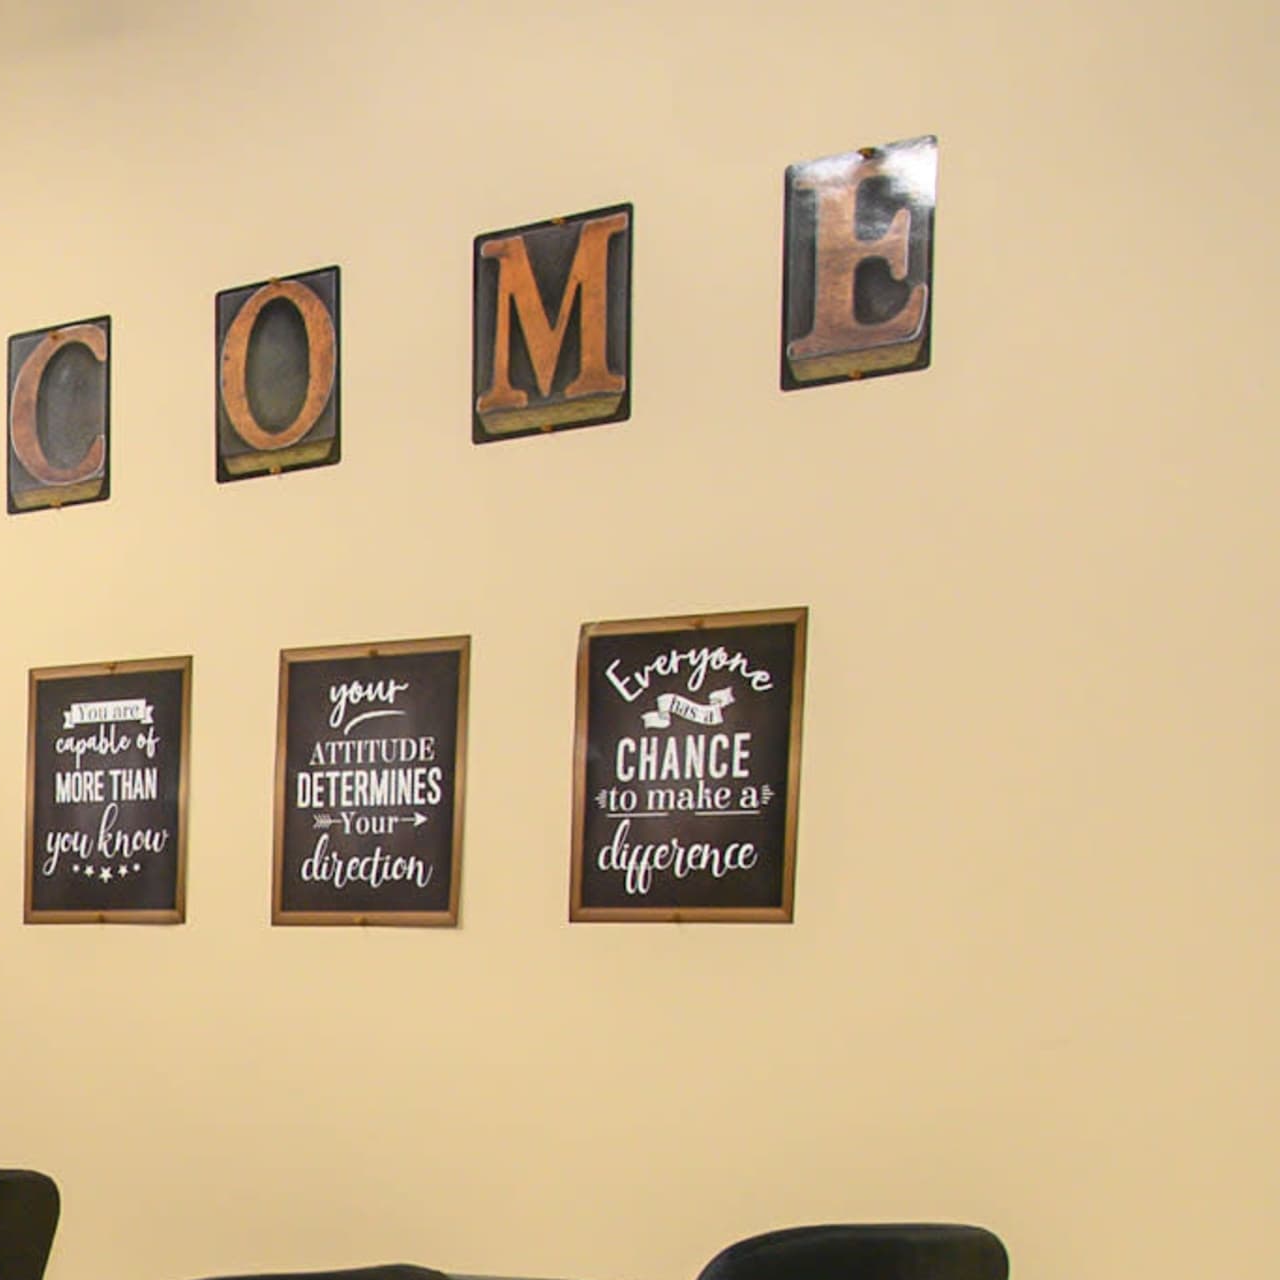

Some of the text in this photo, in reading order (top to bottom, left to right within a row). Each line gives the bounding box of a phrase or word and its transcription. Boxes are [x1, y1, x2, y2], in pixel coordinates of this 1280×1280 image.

[606, 646, 773, 702] Everyone
[77, 704, 140, 721] You are
[328, 679, 409, 728] your
[55, 724, 160, 769] capable of
[309, 737, 436, 766] ATTITUDE
[616, 732, 751, 782] CHANCE
[55, 768, 157, 803] MORE THAN
[297, 767, 443, 808] DETERMINES
[609, 780, 760, 812] to make a
[42, 803, 168, 876] you know
[340, 811, 399, 834] Your
[301, 834, 433, 888] direction
[598, 819, 758, 894] difference
